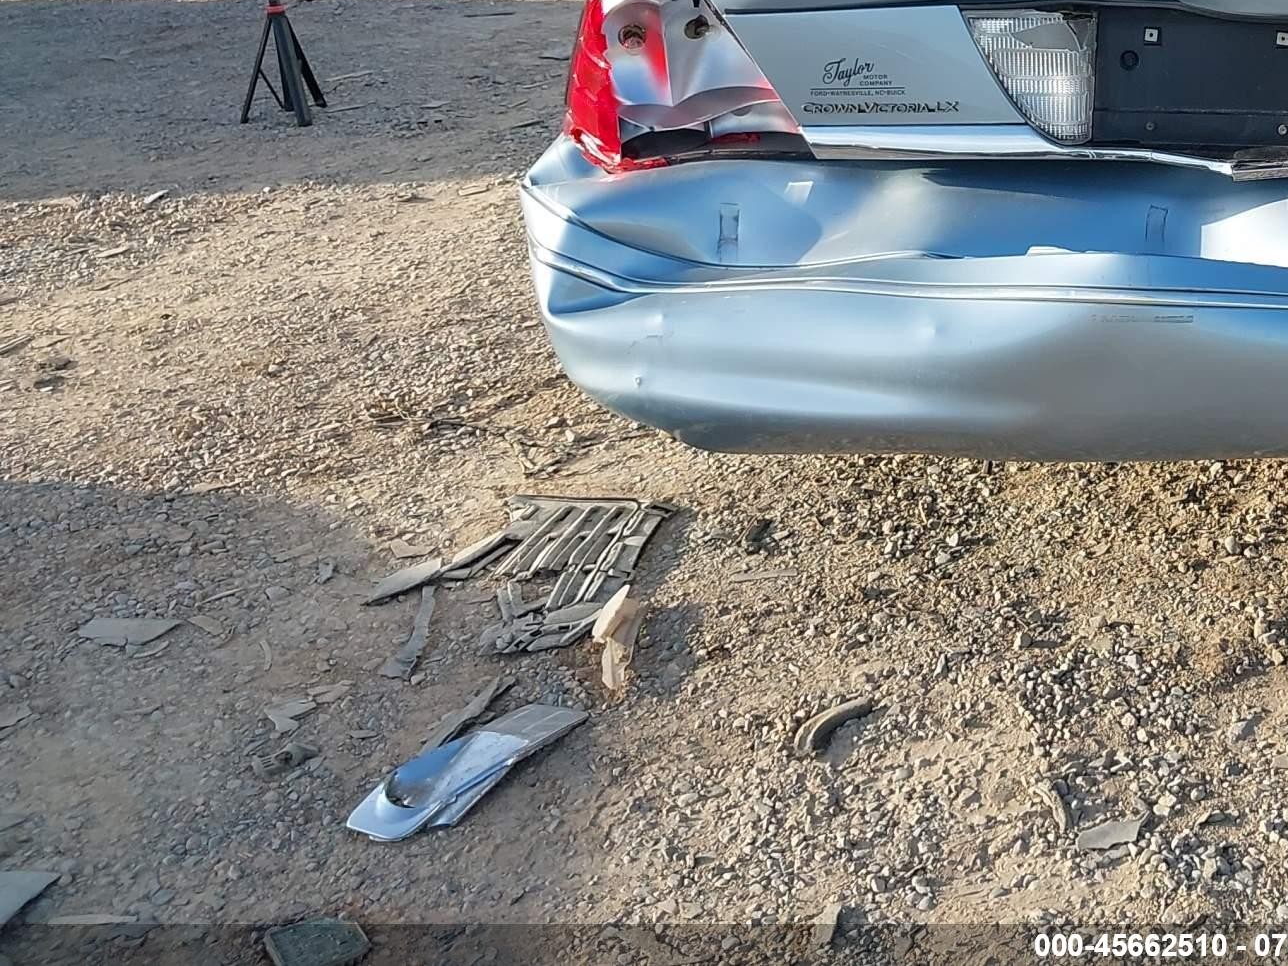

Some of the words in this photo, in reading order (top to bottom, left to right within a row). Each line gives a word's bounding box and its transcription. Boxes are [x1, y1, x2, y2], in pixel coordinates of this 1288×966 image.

[822, 57, 875, 87] Taylor
[802, 101, 860, 114] CROWN
[863, 101, 930, 114] VICTORIA
[936, 100, 960, 112] LX
